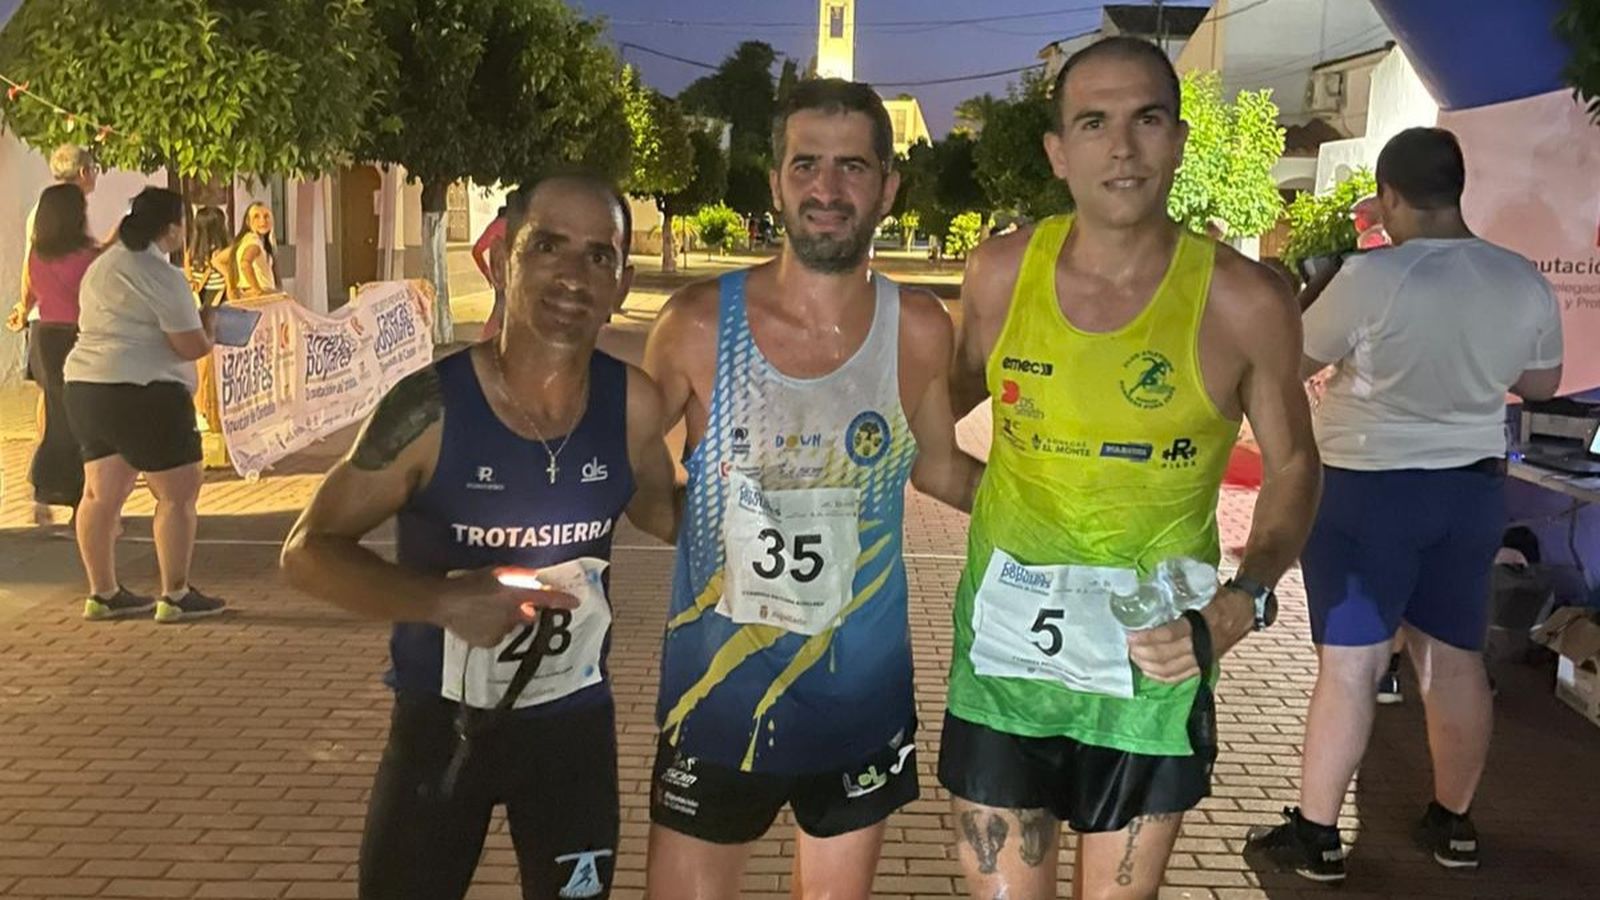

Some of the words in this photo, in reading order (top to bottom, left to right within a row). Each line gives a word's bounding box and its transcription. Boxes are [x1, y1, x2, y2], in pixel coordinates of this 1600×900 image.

[452, 518, 612, 548] TROTASIERRA
[752, 528, 824, 583] 35
[497, 607, 573, 663] 28
[1031, 608, 1065, 657] 5
